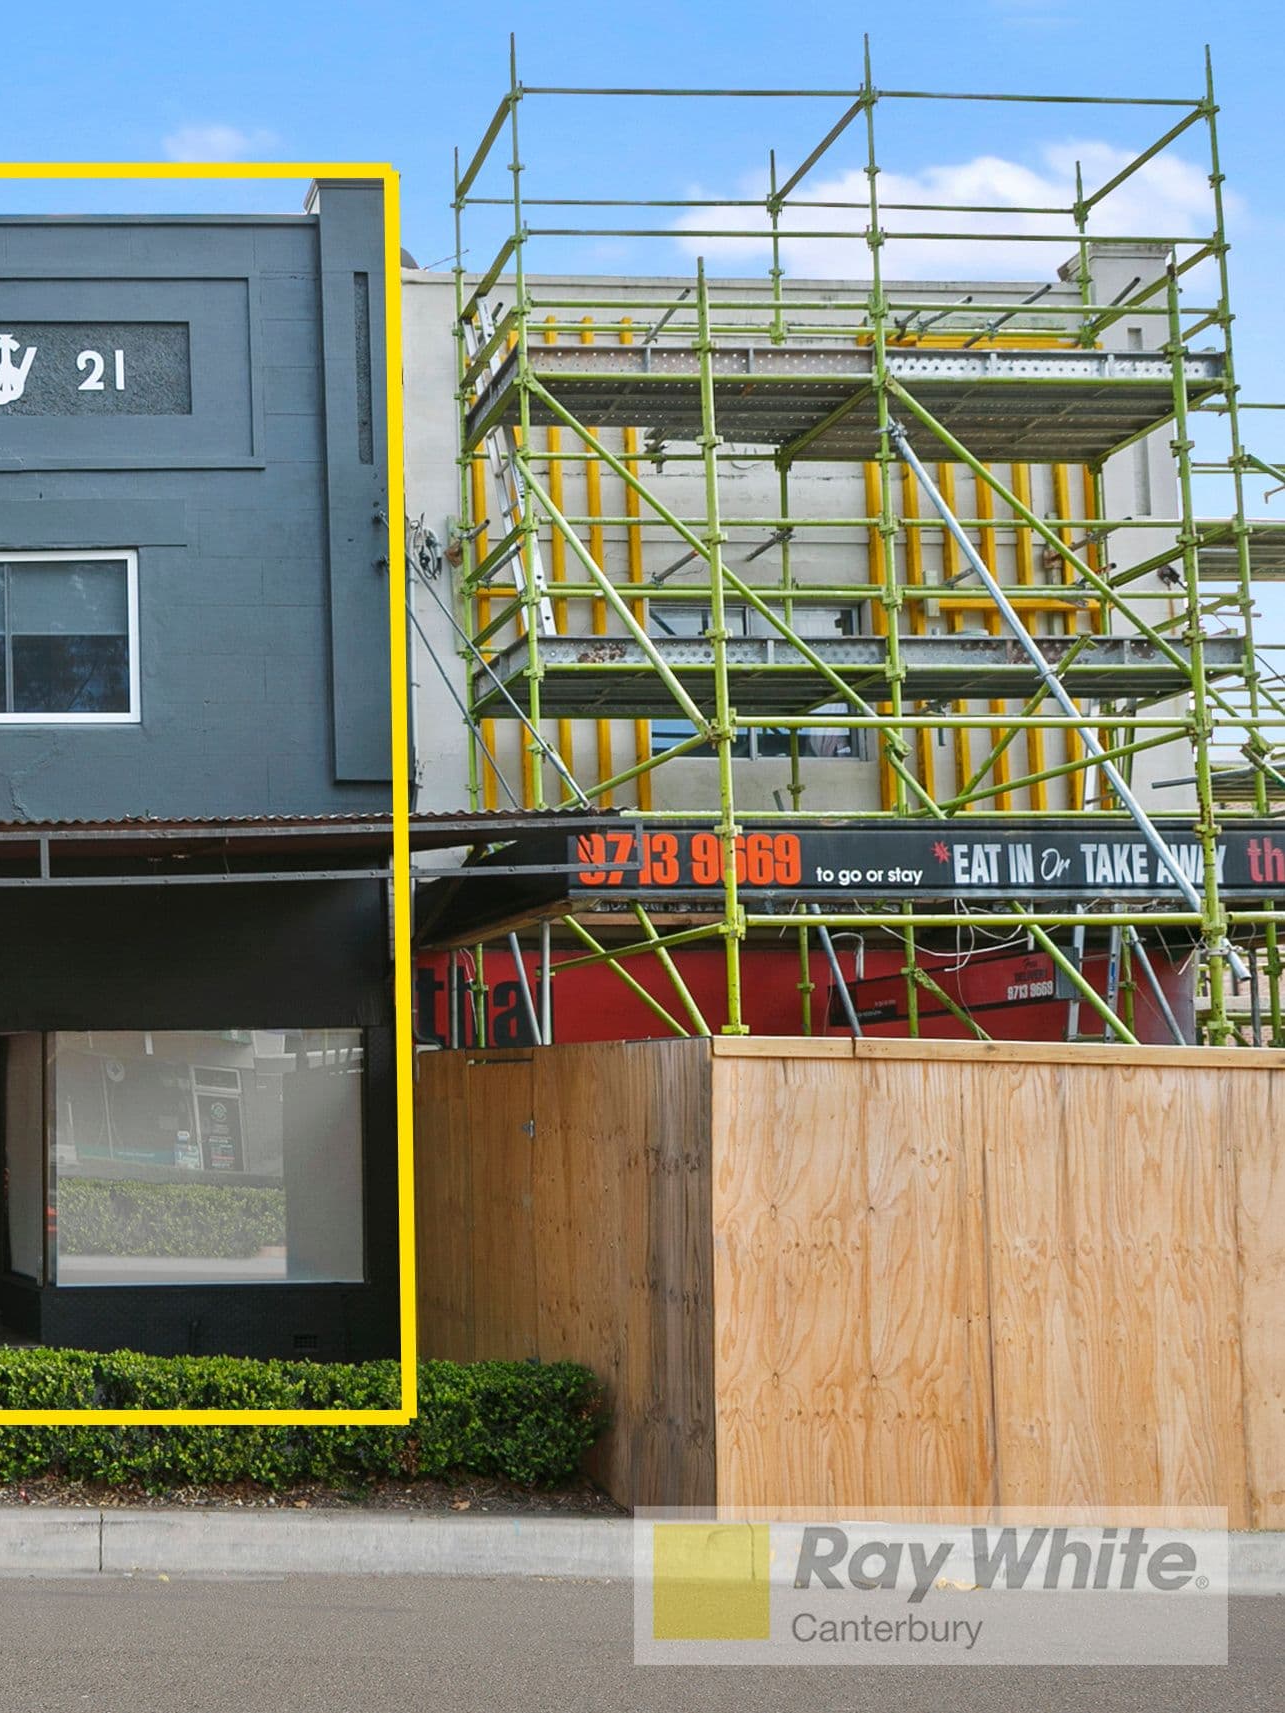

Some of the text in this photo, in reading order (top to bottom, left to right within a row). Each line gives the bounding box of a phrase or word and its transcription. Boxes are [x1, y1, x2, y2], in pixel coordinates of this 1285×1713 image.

[76, 349, 125, 391] 21
[816, 866, 923, 886] to go or stay
[953, 843, 1001, 884] EAT
[1008, 843, 1035, 884] IN
[1040, 848, 1071, 881] Or
[1080, 843, 1149, 884] TAKE
